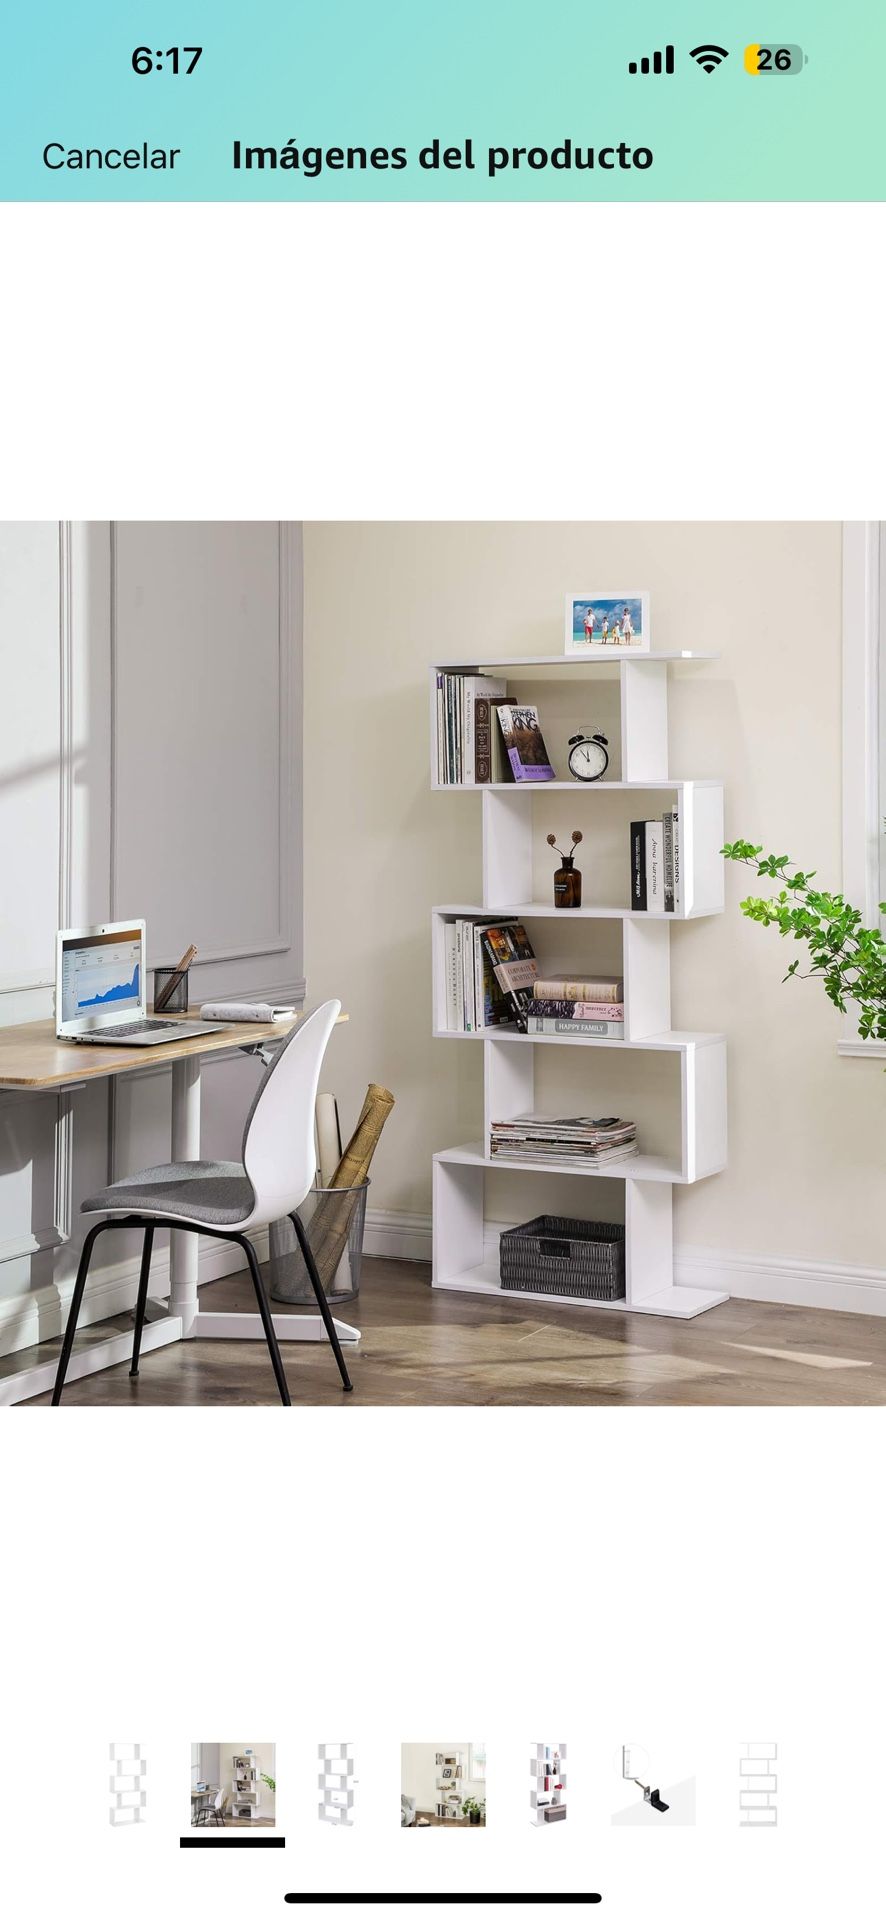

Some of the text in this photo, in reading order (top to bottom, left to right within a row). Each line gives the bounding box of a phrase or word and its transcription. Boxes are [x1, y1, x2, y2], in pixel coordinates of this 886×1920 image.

[512, 717, 538, 731] KING
[558, 1023, 604, 1032] HAPPY FAMILY
